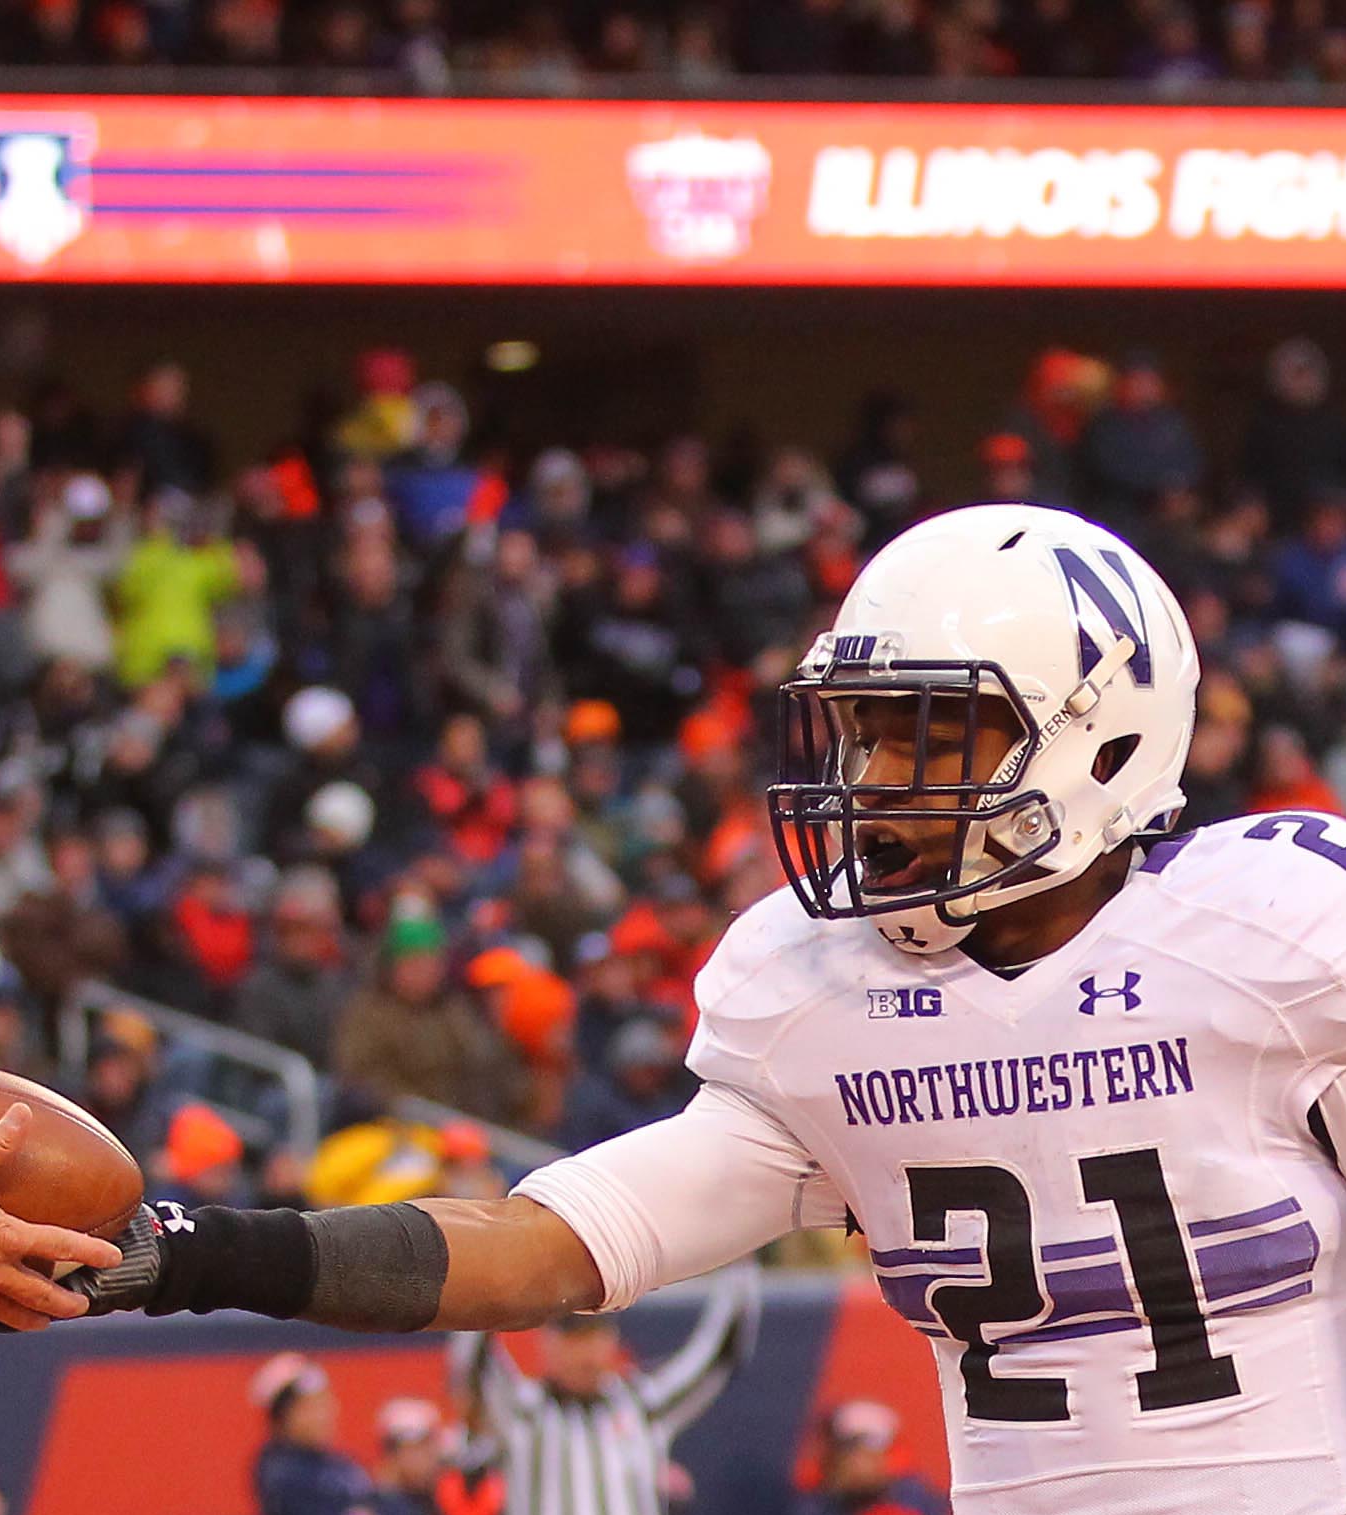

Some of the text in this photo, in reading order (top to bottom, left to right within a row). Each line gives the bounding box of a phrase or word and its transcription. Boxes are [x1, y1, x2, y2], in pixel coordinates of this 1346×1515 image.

[808, 147, 1162, 238] ILLINOIS
[1051, 544, 1154, 689] N
[834, 1037, 1195, 1127] NORTHWESTERN
[902, 1143, 1244, 1425] 21
